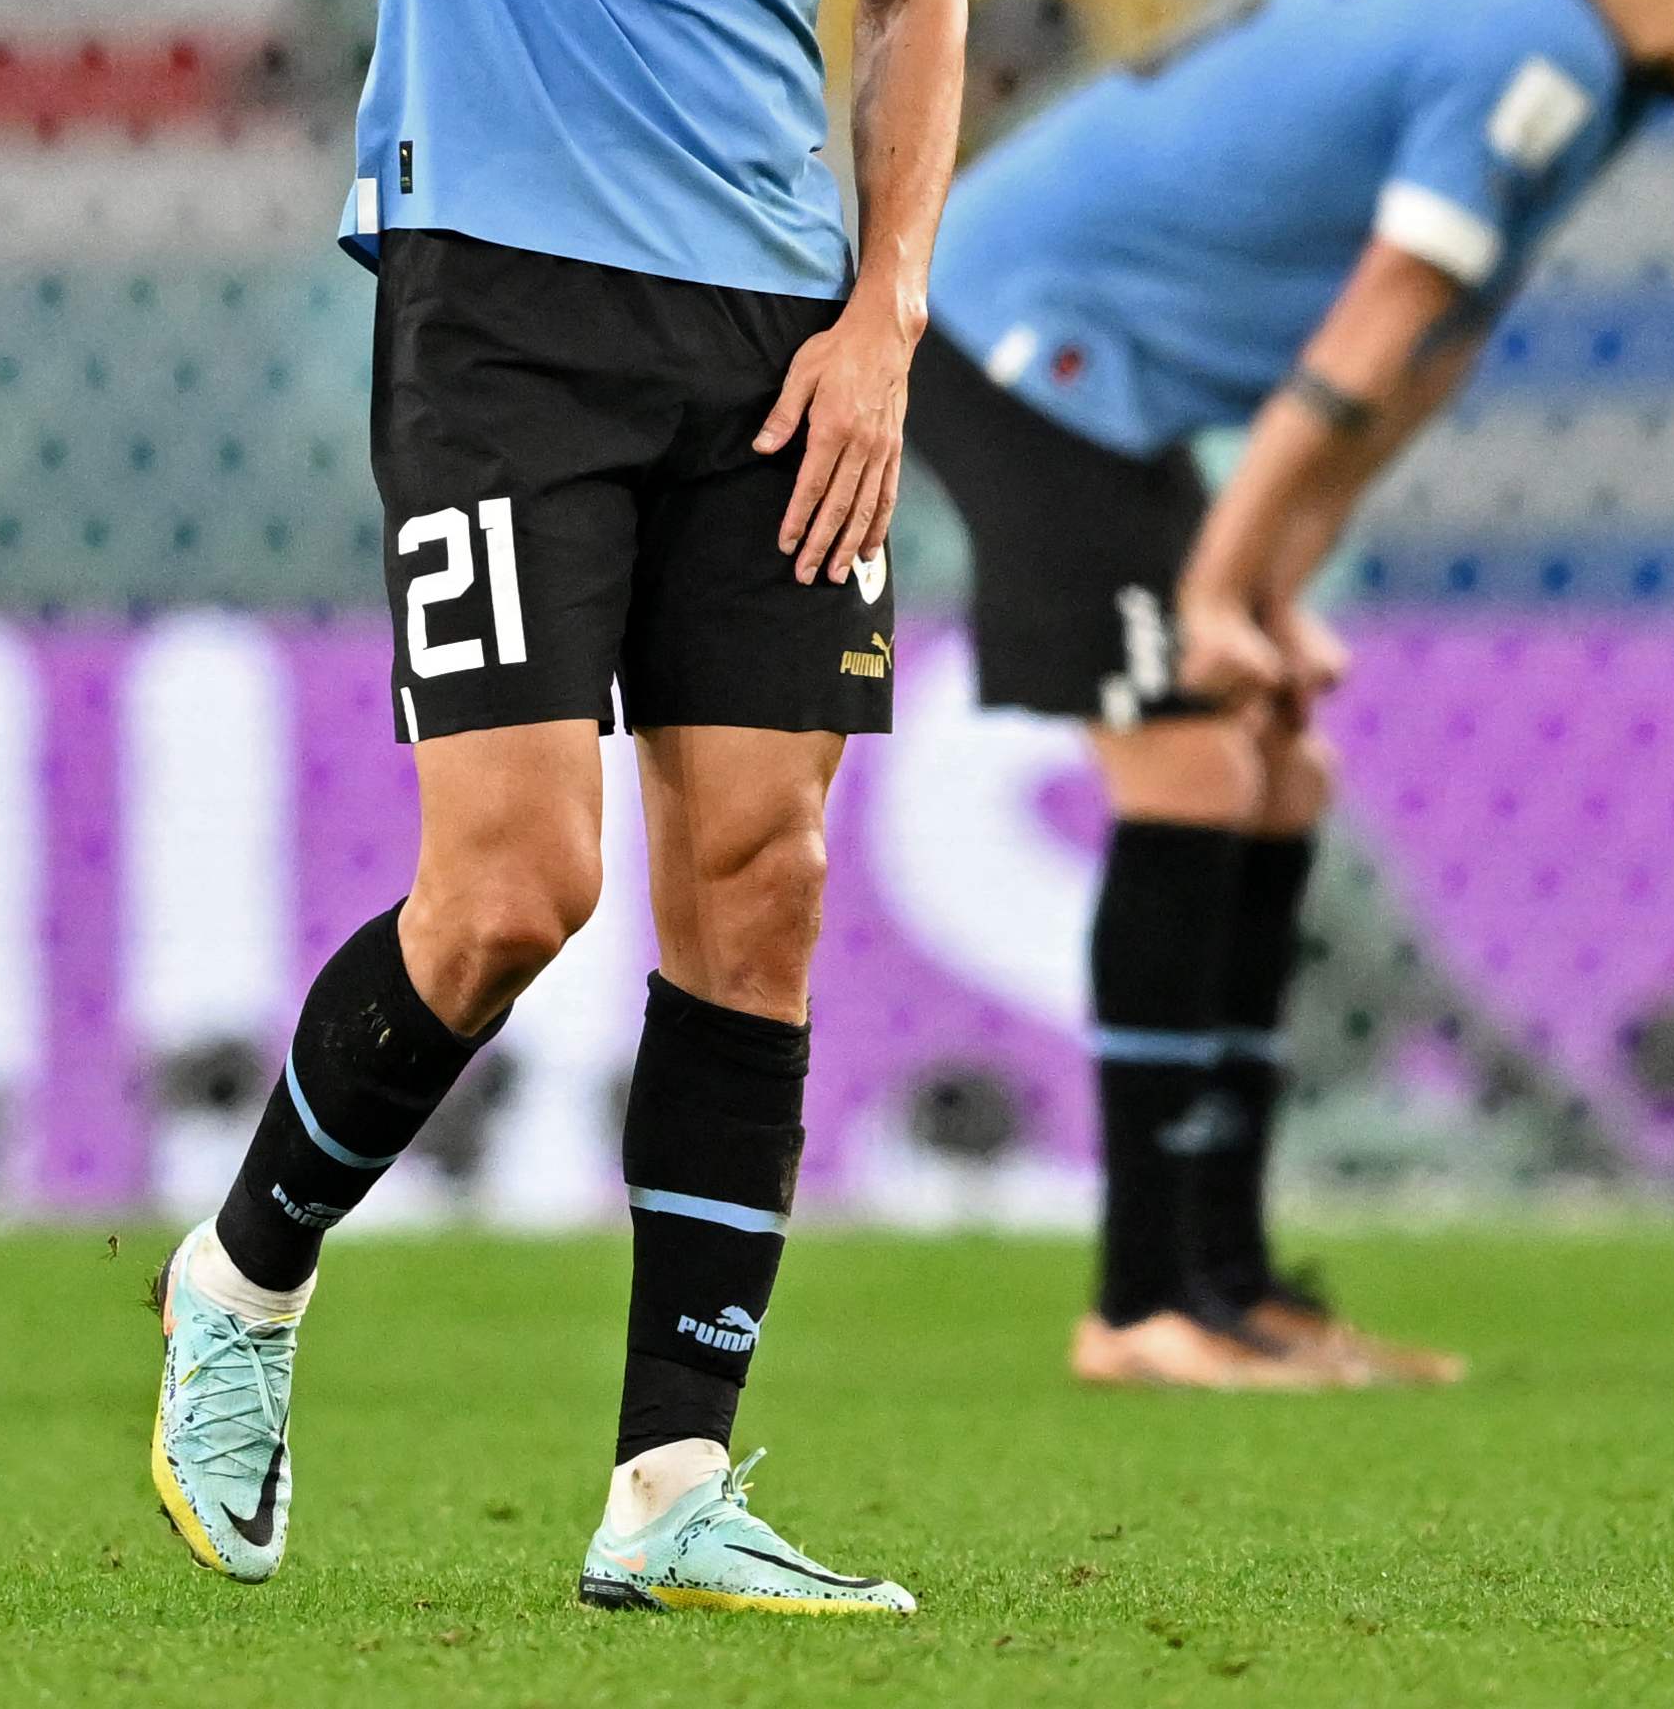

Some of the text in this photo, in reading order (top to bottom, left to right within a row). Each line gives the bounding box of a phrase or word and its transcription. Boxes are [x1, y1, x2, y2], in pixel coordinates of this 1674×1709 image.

[398, 497, 527, 679] 21
[840, 651, 884, 678] PUMA
[677, 1314, 754, 1352] PUMA
